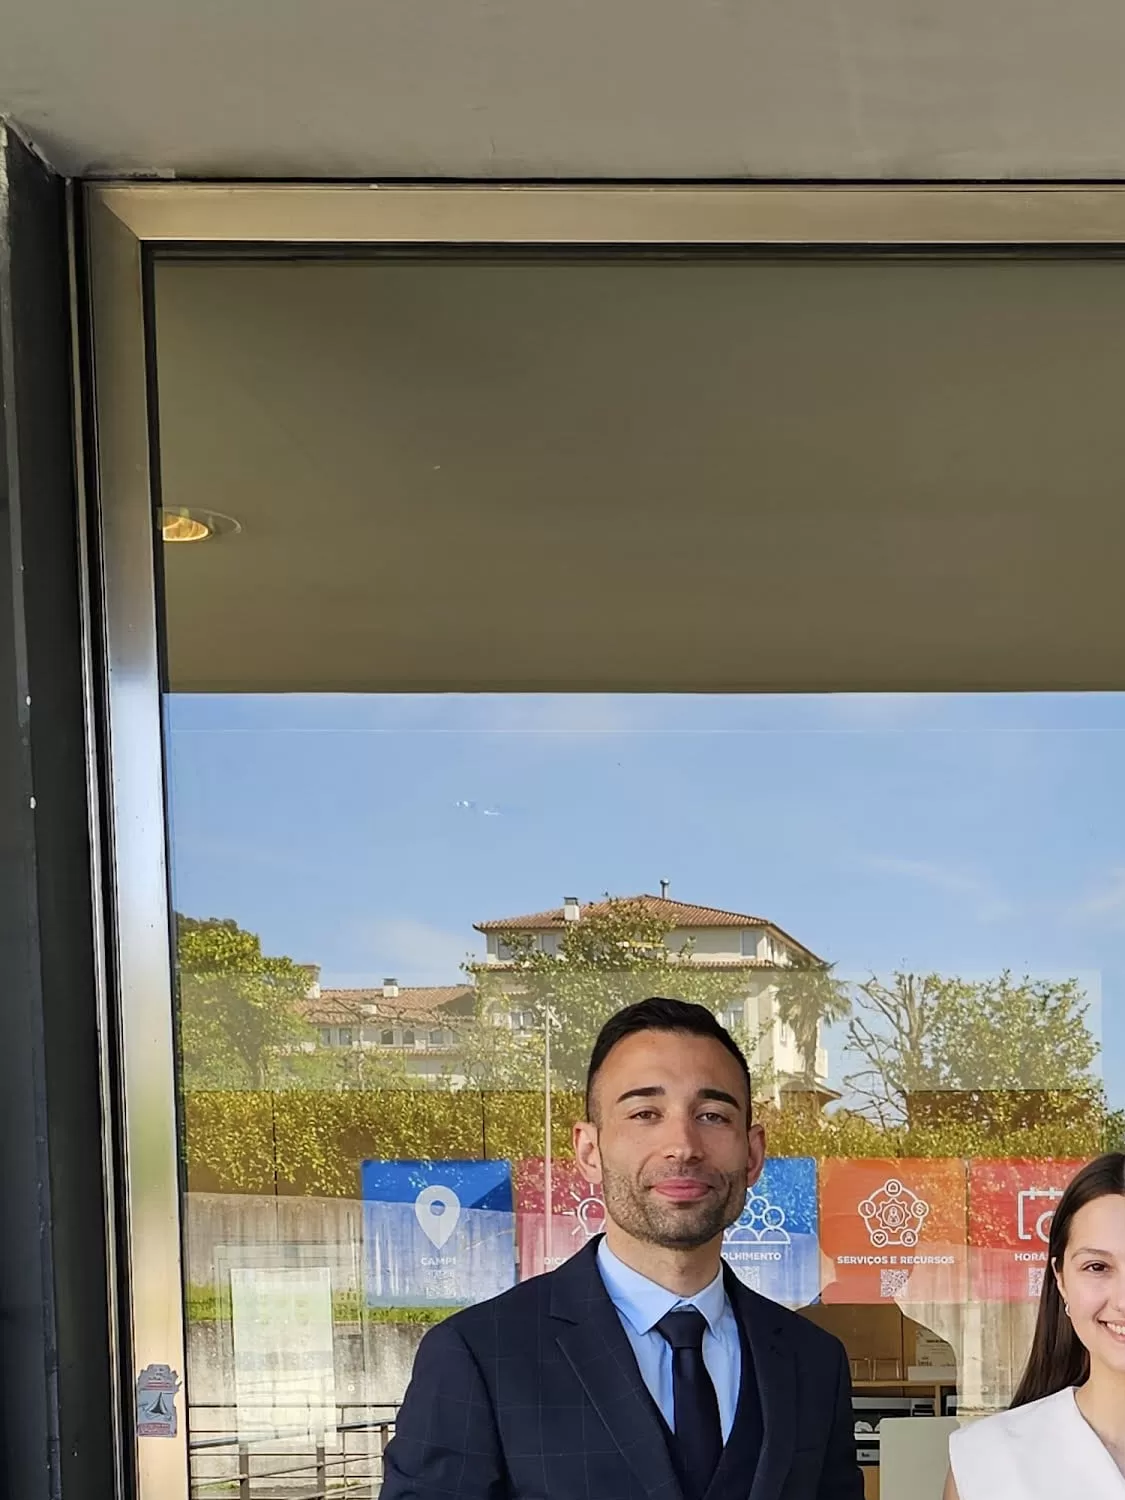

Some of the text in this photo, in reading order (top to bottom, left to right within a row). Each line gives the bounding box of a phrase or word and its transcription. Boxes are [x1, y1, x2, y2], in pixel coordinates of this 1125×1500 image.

[837, 1255, 955, 1266] SERVIÇOS E RECURSOS
